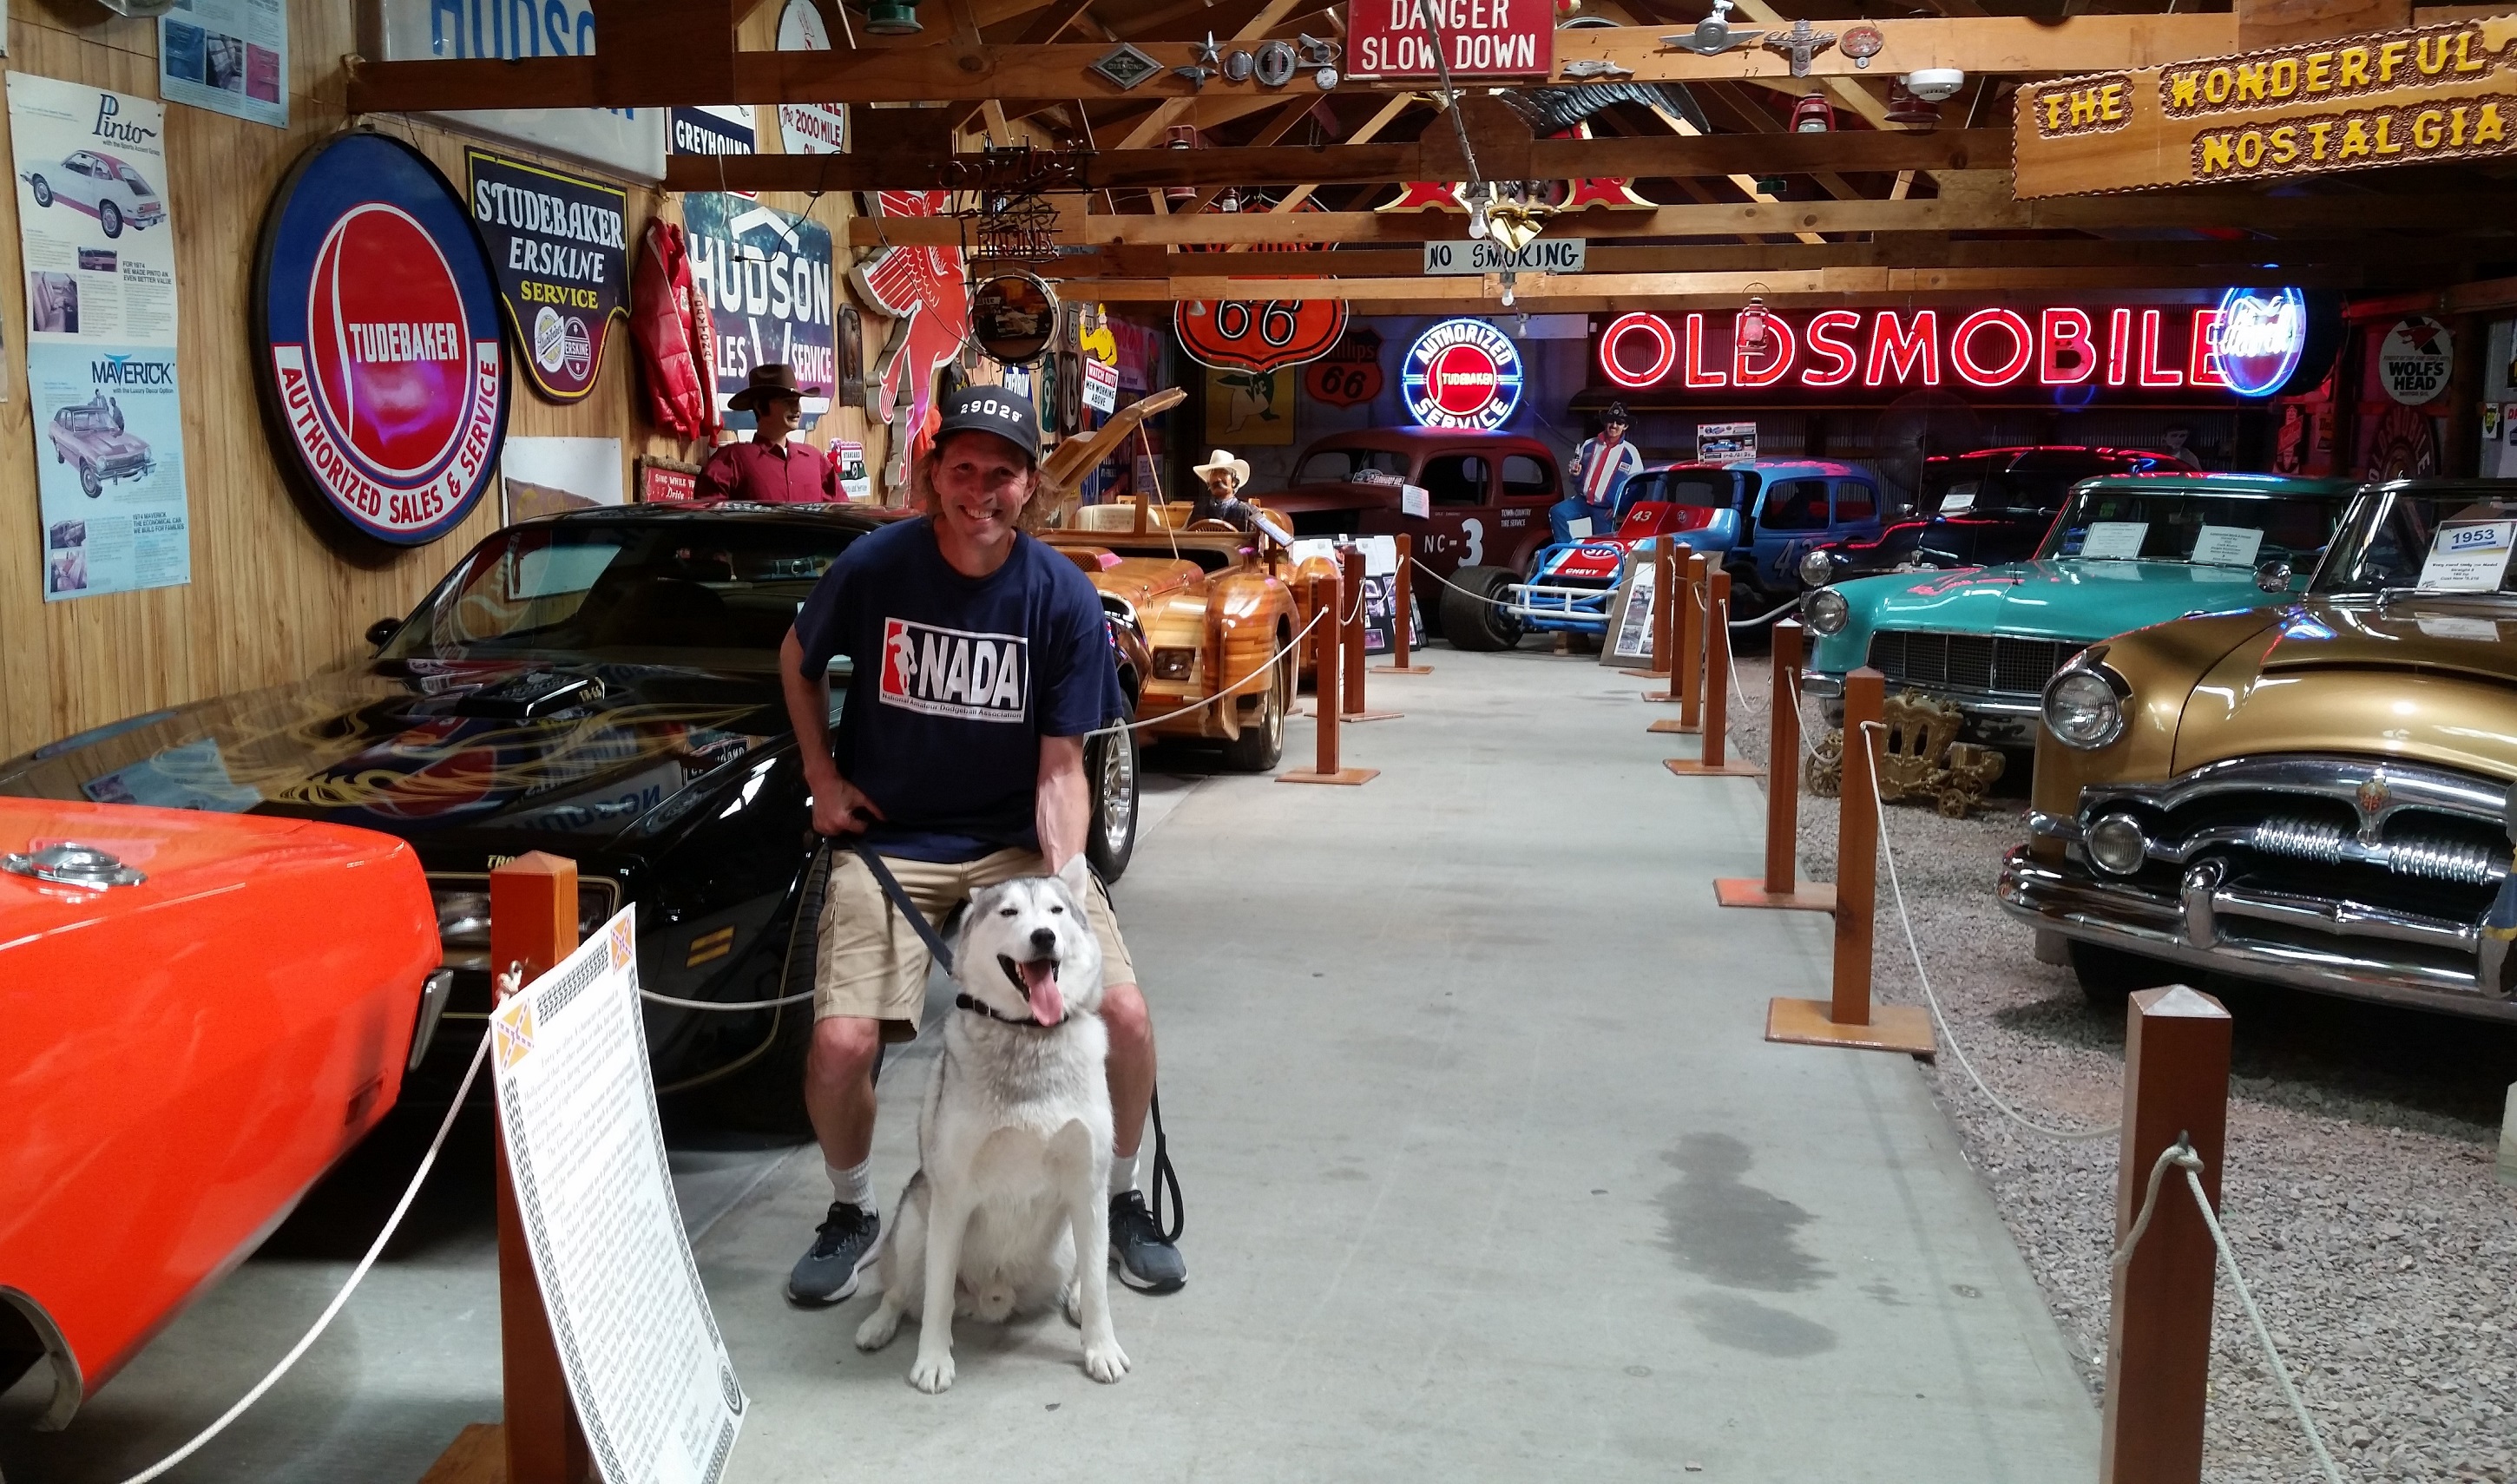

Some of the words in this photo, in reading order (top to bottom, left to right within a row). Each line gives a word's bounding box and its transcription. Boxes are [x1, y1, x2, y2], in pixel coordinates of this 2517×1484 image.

[1390, 0, 1510, 30] DANGER
[1362, 36, 1439, 70] SLOW
[1455, 34, 1536, 69] DOWN
[2041, 82, 2126, 130] THE
[2172, 31, 2487, 108] WONDERFUL
[92, 93, 156, 143] Pinto
[796, 108, 819, 138] 2000
[820, 119, 841, 147] MILE
[2201, 102, 2505, 174] NOSTALGIA
[476, 179, 627, 251] STUDEBAKER
[509, 236, 606, 284] ERSKINE
[1428, 244, 1453, 272] NO
[1472, 242, 1580, 269] SMOKING
[521, 280, 599, 310] SERVICE
[690, 233, 830, 326] HUDSON
[1218, 299, 1303, 348] 66
[565, 342, 589, 356] ERSKINE
[717, 334, 747, 379] LES
[792, 342, 832, 384] SERVICE
[1415, 324, 1513, 366] AUTHORIZED
[1600, 307, 2228, 388] OLDSMOBILE
[92, 361, 173, 386] MAVERICK
[1088, 364, 1105, 384] WATCH
[1321, 366, 1366, 399] 66
[2389, 362, 2444, 377] WOLF'S
[2394, 376, 2436, 391] HEAD
[1414, 397, 1509, 430] SERVICE
[279, 366, 382, 518] AUTHORIZED
[389, 486, 445, 524] SALES
[447, 476, 462, 499] &
[460, 359, 497, 478] SERVICE
[666, 483, 685, 501] Drive
[669, 476, 687, 487] WHILE
[1632, 510, 1653, 522] 43
[2453, 529, 2494, 543] 1953
[1565, 568, 1599, 576] CHEVY
[918, 633, 1020, 709] NADA
[882, 693, 910, 704] National
[910, 699, 939, 711] Amateur
[940, 705, 977, 717] Dodgeball
[978, 710, 1022, 719] Association
